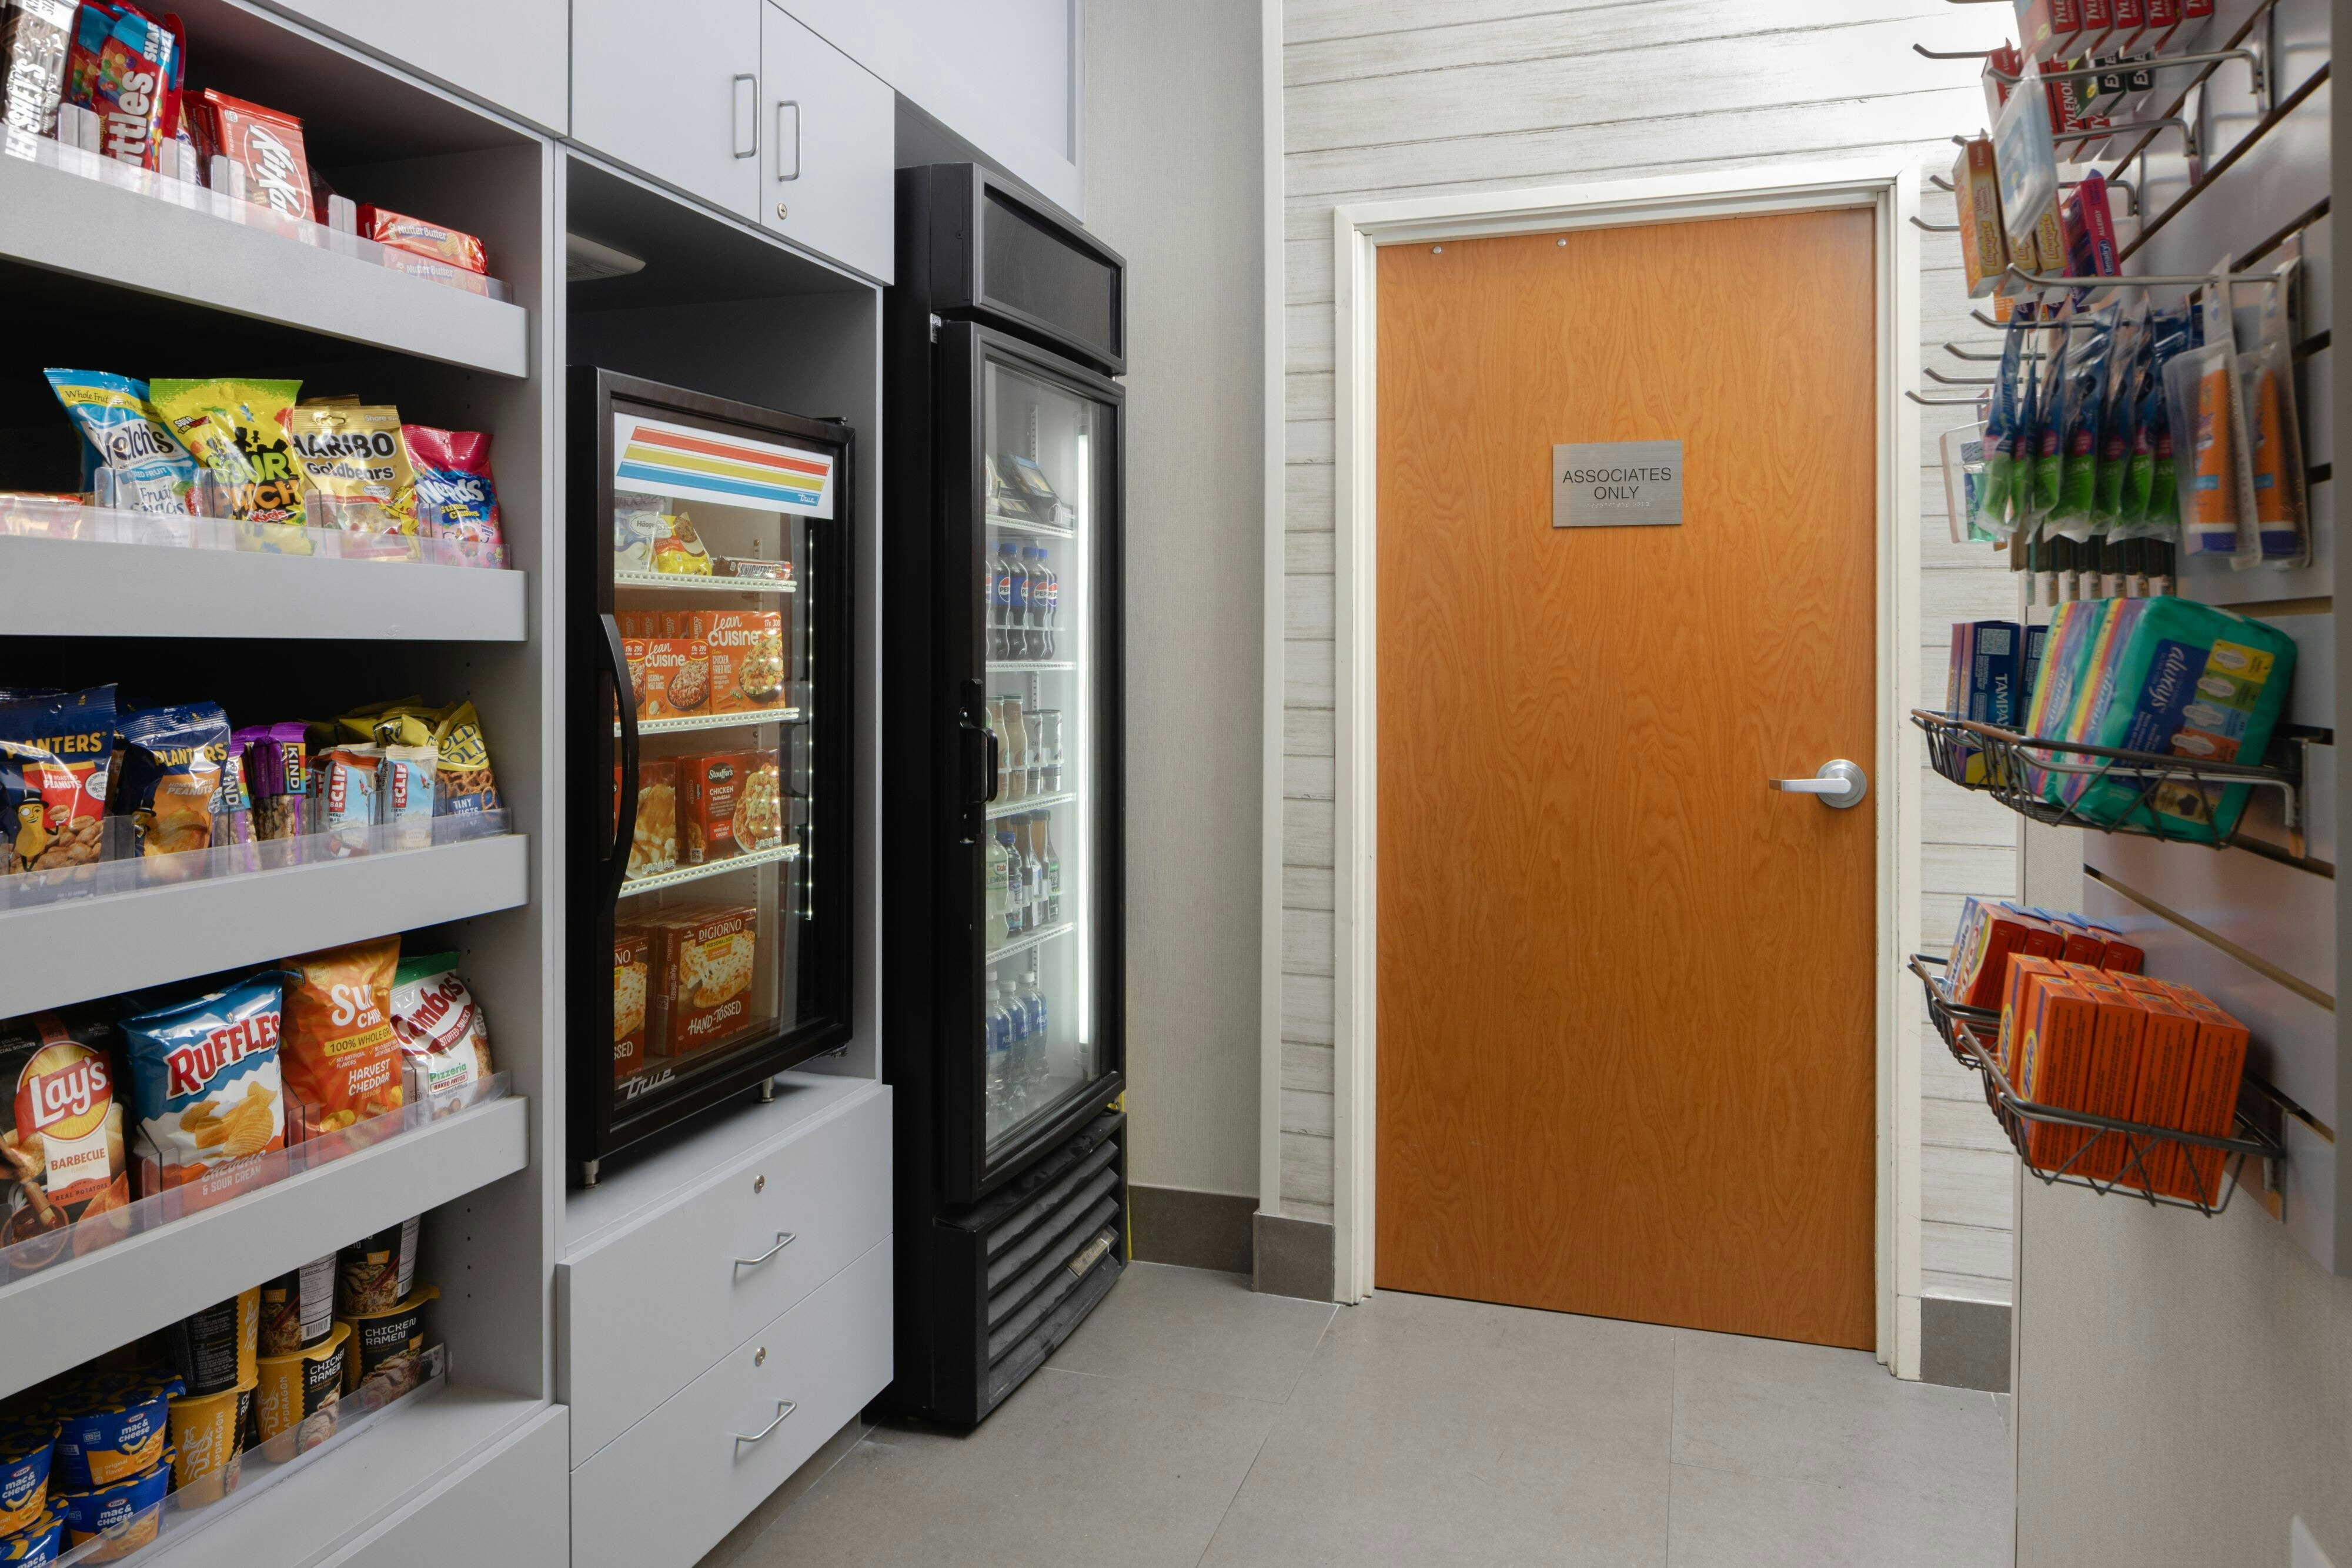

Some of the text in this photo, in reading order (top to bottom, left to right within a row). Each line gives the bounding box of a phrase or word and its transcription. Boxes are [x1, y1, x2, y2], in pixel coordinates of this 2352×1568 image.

[2061, 79, 2080, 133] TYLENOL
[107, 71, 154, 166] ittles
[248, 123, 301, 219] KitKa
[2094, 209, 2105, 236] ALLERGY
[397, 225, 447, 241] Nutter Butter
[2102, 243, 2113, 273] Benadryl
[65, 390, 109, 404] Whole Fruit
[173, 416, 194, 428] SOUR
[293, 432, 397, 459] HARIBO
[145, 467, 168, 478] FRUIT
[208, 452, 289, 484] SOUR
[306, 461, 395, 481] Goldbears
[1563, 467, 1672, 484] ASSOCIATES
[139, 484, 172, 502] Fruit
[210, 479, 301, 519] PATCH
[414, 479, 485, 504] Nerds
[797, 493, 816, 504] true
[1594, 486, 1639, 500] ONLY
[249, 509, 289, 523] Kids
[713, 614, 743, 633] Lean
[773, 619, 781, 627] 300
[648, 641, 673, 657] Lean
[712, 655, 730, 665] CHICKEN
[713, 665, 724, 675] FRIED
[2148, 646, 2189, 708] always
[442, 724, 477, 753] OLD
[153, 743, 228, 767] PLANTRS
[447, 738, 486, 765] OLD
[288, 747, 300, 789] KIND
[708, 767, 734, 780] Stouffer's
[43, 779, 83, 790] PEANUTS
[166, 784, 214, 795] PEANUTS
[330, 766, 346, 802] CLIF
[394, 764, 407, 798] CLIF
[709, 785, 734, 796] CHICKEN
[452, 797, 472, 810] TINY
[988, 875, 1008, 884] LEMONA
[698, 918, 743, 941] DIGIORNO
[706, 940, 726, 948] PERSONAL
[357, 1008, 382, 1028] CHIP
[390, 972, 465, 1045] Combos
[687, 1000, 741, 1035] HAND-TOSSED
[440, 1009, 471, 1047] STUFFED SNACKS
[329, 1038, 356, 1054] 100%
[358, 1030, 382, 1047] WHOLE
[167, 1014, 280, 1097] RUFFLES
[336, 1059, 357, 1069] FLAVORS
[348, 1058, 391, 1085] HARVEST
[429, 1062, 467, 1082] Pizzeria
[433, 1073, 466, 1090] BAKED PRETZEL
[29, 1056, 108, 1130] Lay's
[348, 1071, 390, 1096] CHEDDAR
[618, 1068, 676, 1101] true
[51, 1147, 106, 1171] BARBECUE
[202, 1149, 266, 1183] CHEDDAR
[202, 1164, 262, 1196] & SOUR CREAM
[55, 1182, 108, 1202] REAL POTATOES
[365, 1317, 417, 1338] CHICKEN
[366, 1330, 406, 1346] RAMEN
[309, 1361, 342, 1385] RAMEN
[121, 1418, 149, 1435] mac &
[215, 1411, 224, 1482] SAPDRAGON
[104, 1457, 128, 1470] original
[105, 1466, 124, 1476] flavor
[5, 1470, 35, 1490] mac &
[100, 1504, 132, 1519] mac &
[38, 1552, 46, 1562] &
